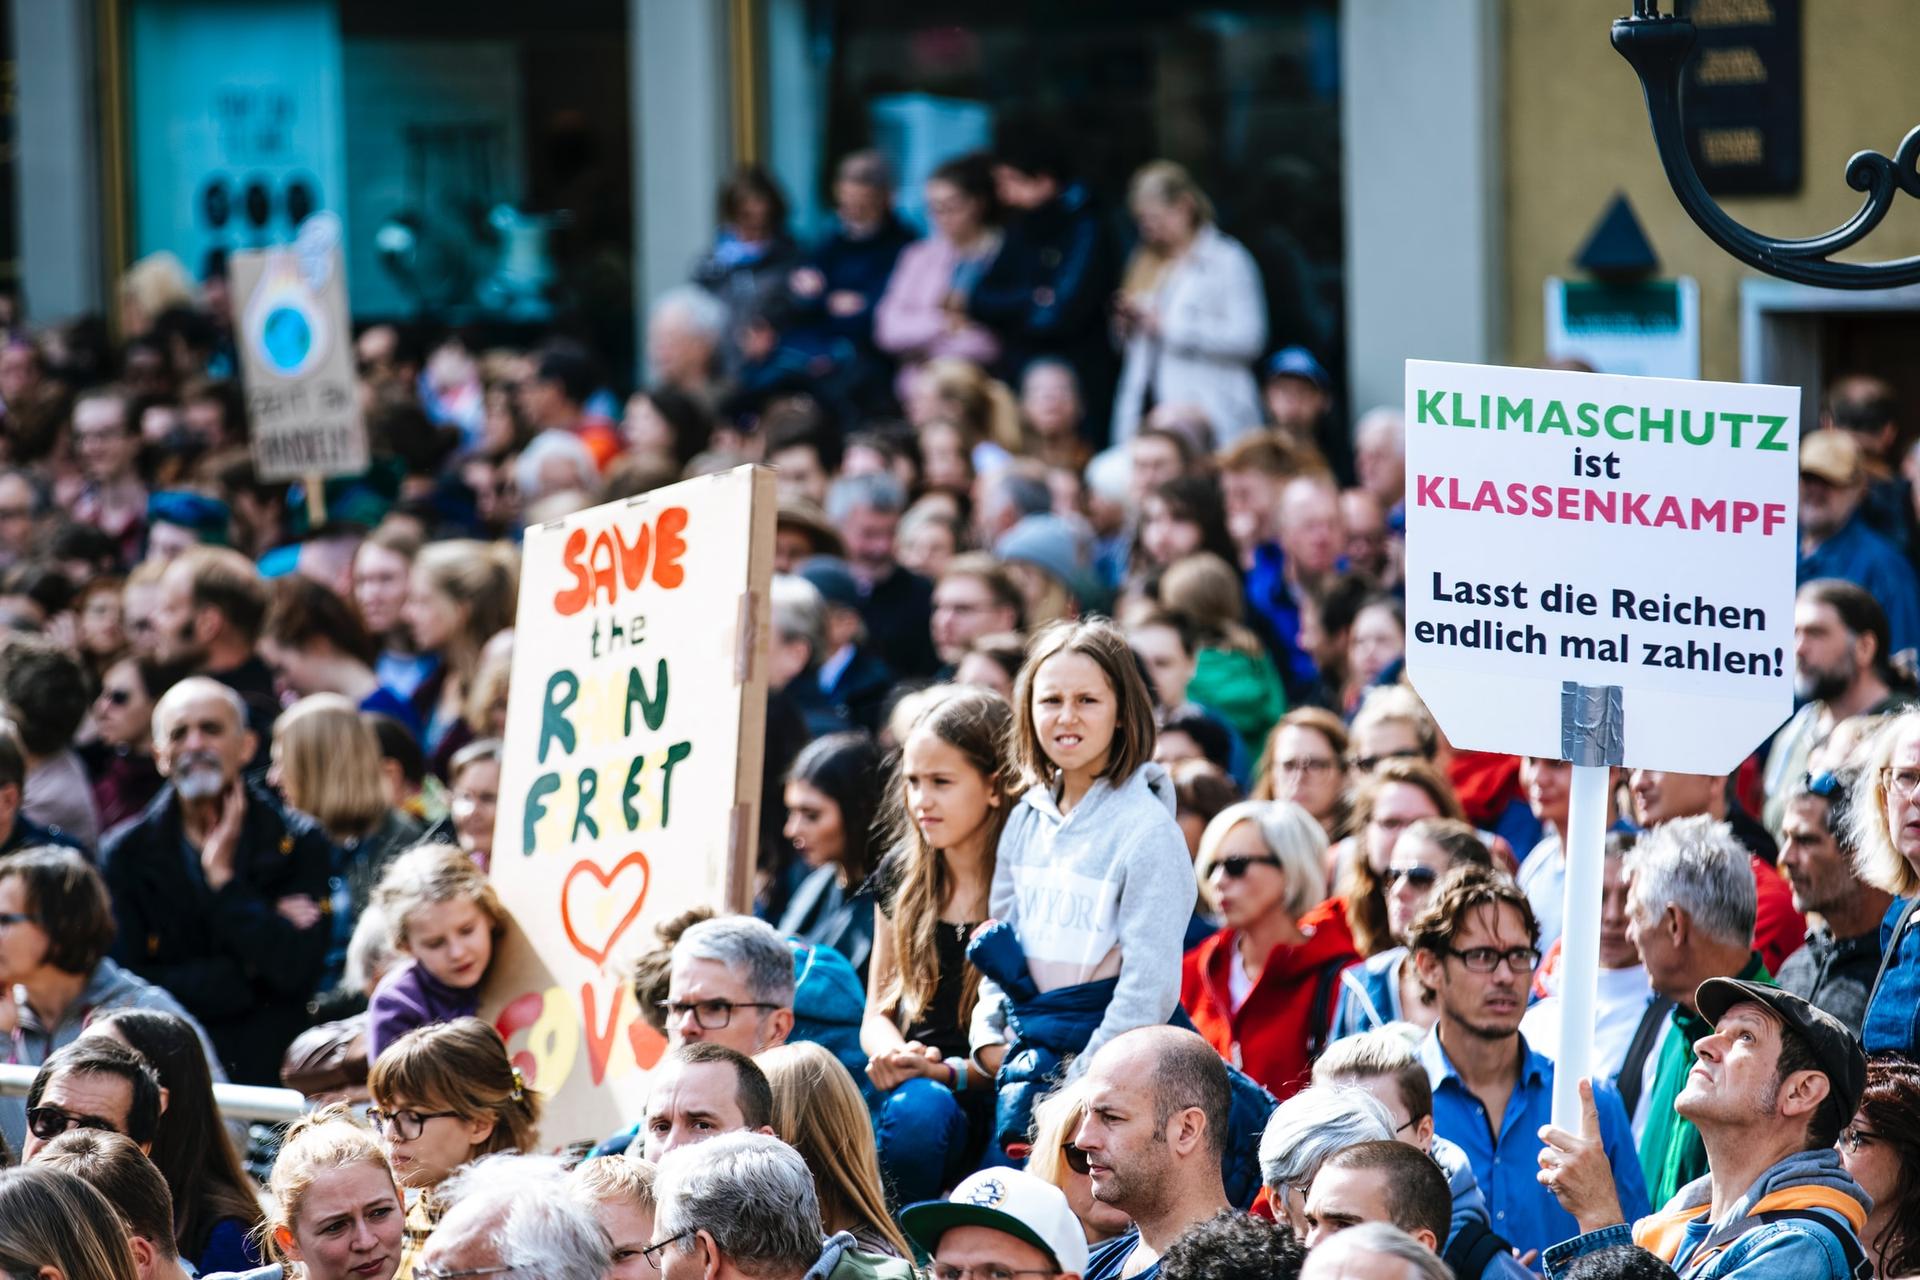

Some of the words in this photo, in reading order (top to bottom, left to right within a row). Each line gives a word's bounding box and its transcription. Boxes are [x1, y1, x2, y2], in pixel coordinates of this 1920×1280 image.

[1416, 389, 1790, 452] KLIMASCHUTZ
[1573, 446, 1621, 479] ist
[1416, 474, 1786, 536] KLASSENKAMPF
[553, 506, 688, 616] SAVE
[1432, 571, 1528, 610] Lasst
[1540, 582, 1598, 616] die
[1611, 588, 1767, 631] Reichen
[591, 615, 646, 659] the
[1414, 619, 1547, 655] endlich
[1560, 633, 1629, 664] mal
[1641, 640, 1784, 678] zahlen!
